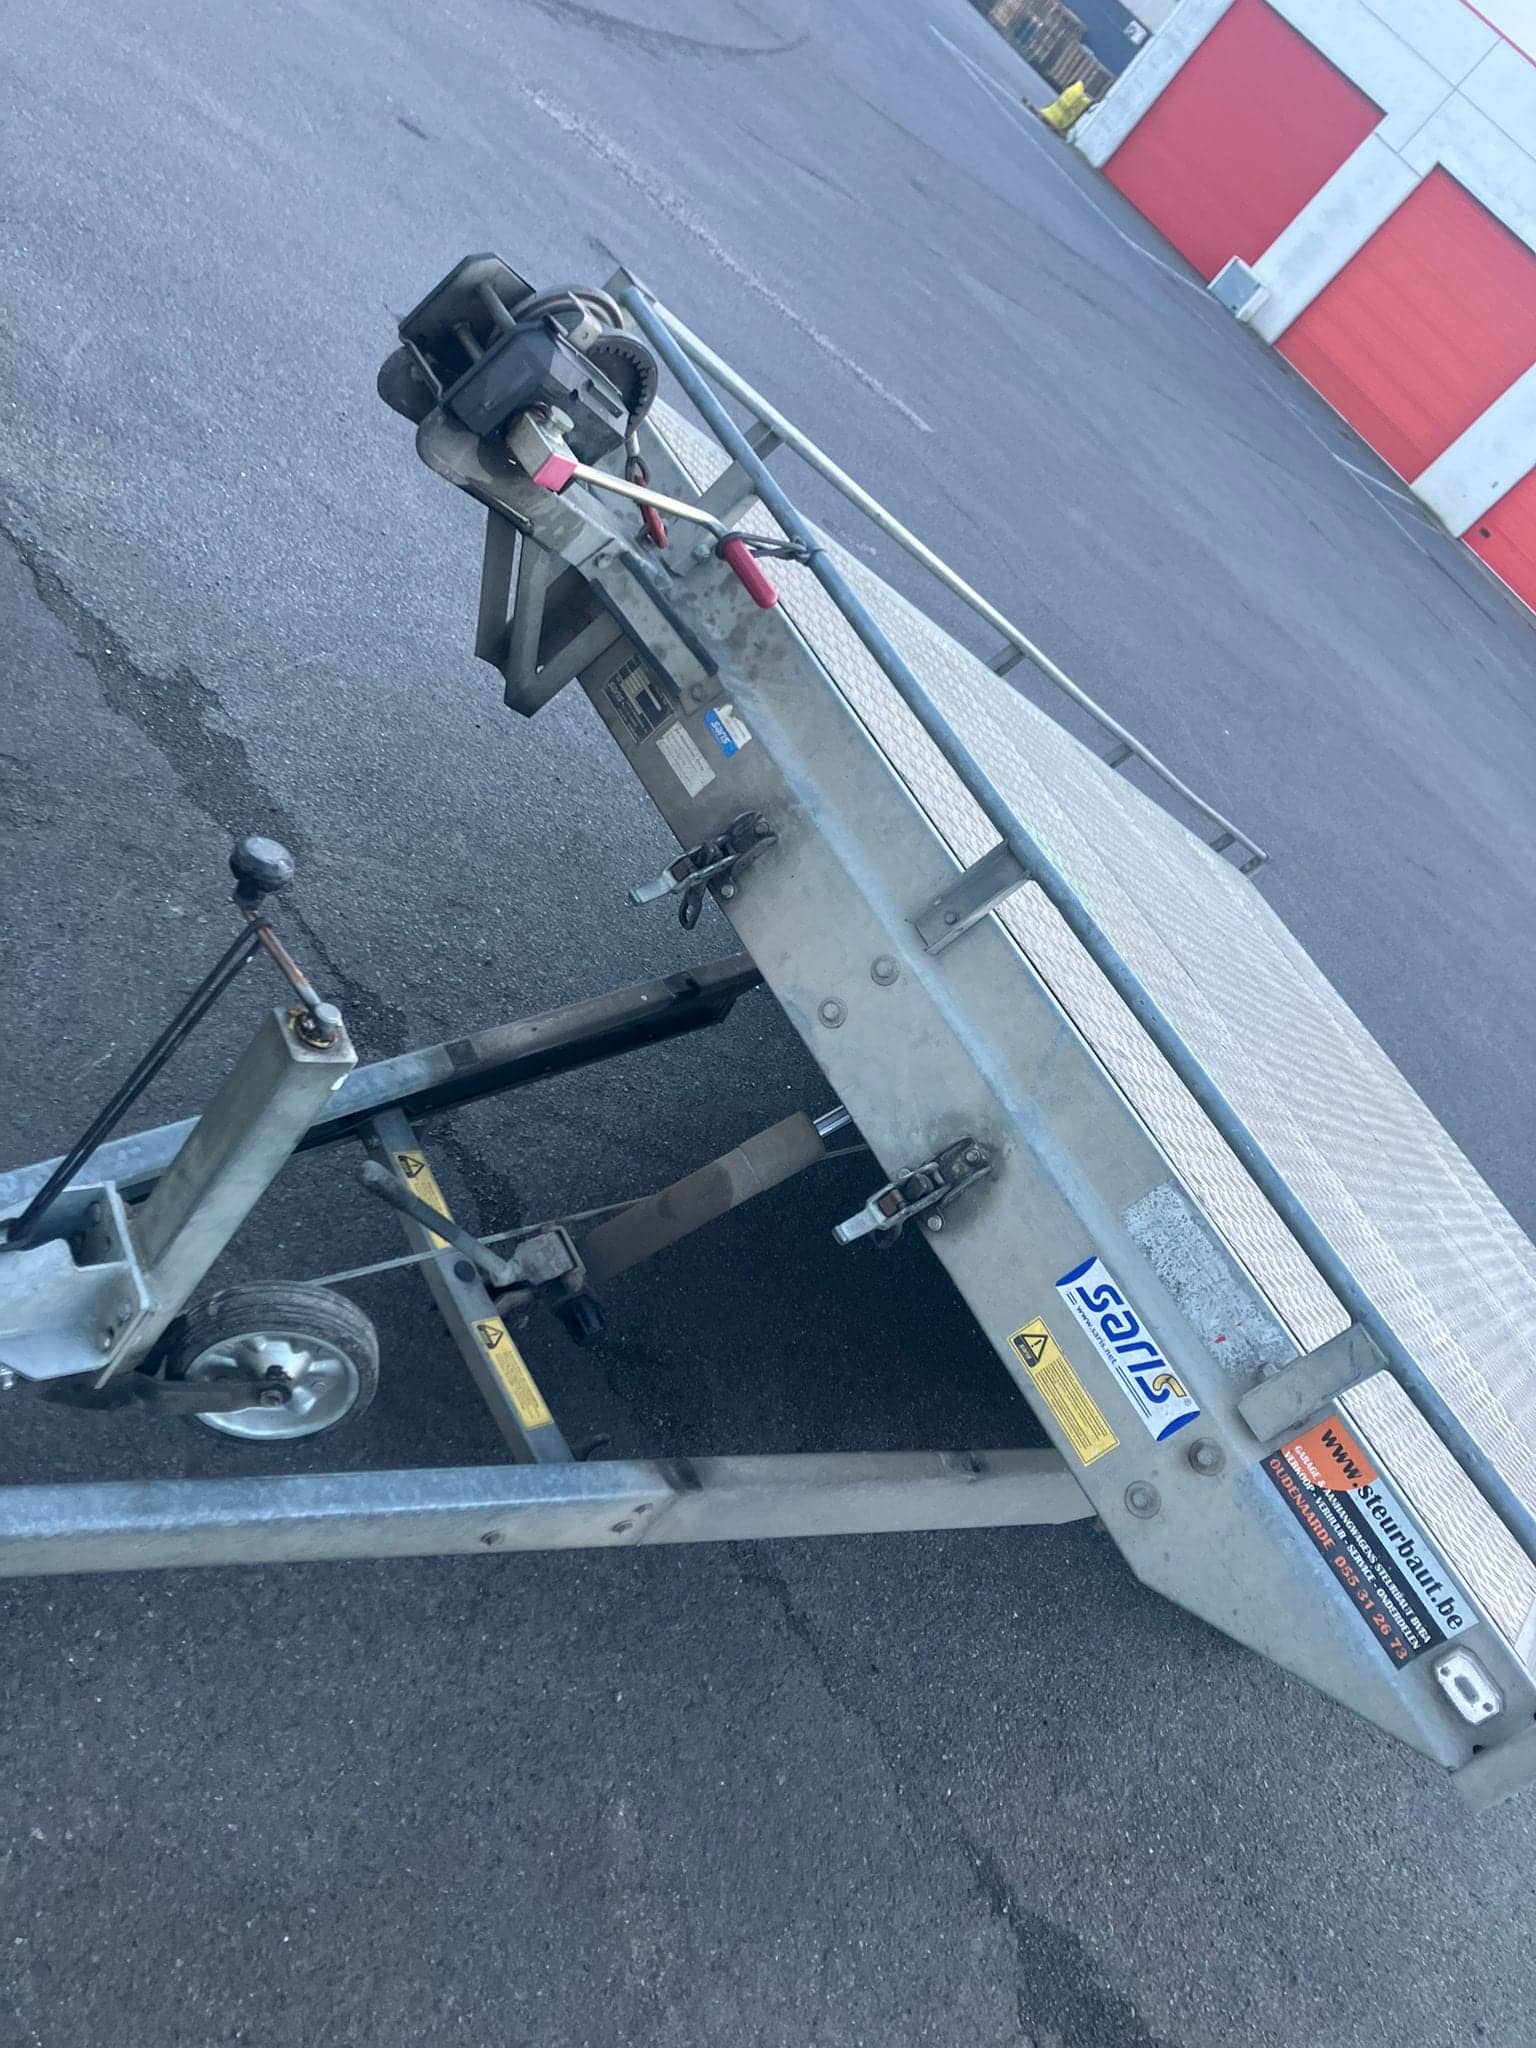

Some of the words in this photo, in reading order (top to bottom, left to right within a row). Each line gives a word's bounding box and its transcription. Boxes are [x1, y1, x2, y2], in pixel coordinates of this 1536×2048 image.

[1074, 1304, 1118, 1365] www.saris.net
[1075, 1283, 1187, 1404] saris
[1292, 1444, 1321, 1480] GARAGE
[1316, 1478, 1327, 1488] &
[1266, 1456, 1336, 1550] OUDENAARDE
[1332, 1553, 1360, 1588] 055
[1354, 1587, 1376, 1611] 31
[1371, 1611, 1393, 1636] 26
[1388, 1636, 1409, 1661] 73
[1282, 1450, 1315, 1493] VERKOOP
[1313, 1496, 1347, 1540] VERHUUR
[1345, 1543, 1377, 1584] SERVICE
[1374, 1586, 1422, 1650] ONDERDELEN
[1320, 1427, 1464, 1631] www.steurbaut.be
[1321, 1486, 1379, 1564] AANHANGWAGENS
[1372, 1562, 1414, 1617] STEURBAUT
[1409, 1615, 1432, 1644] BVBA
